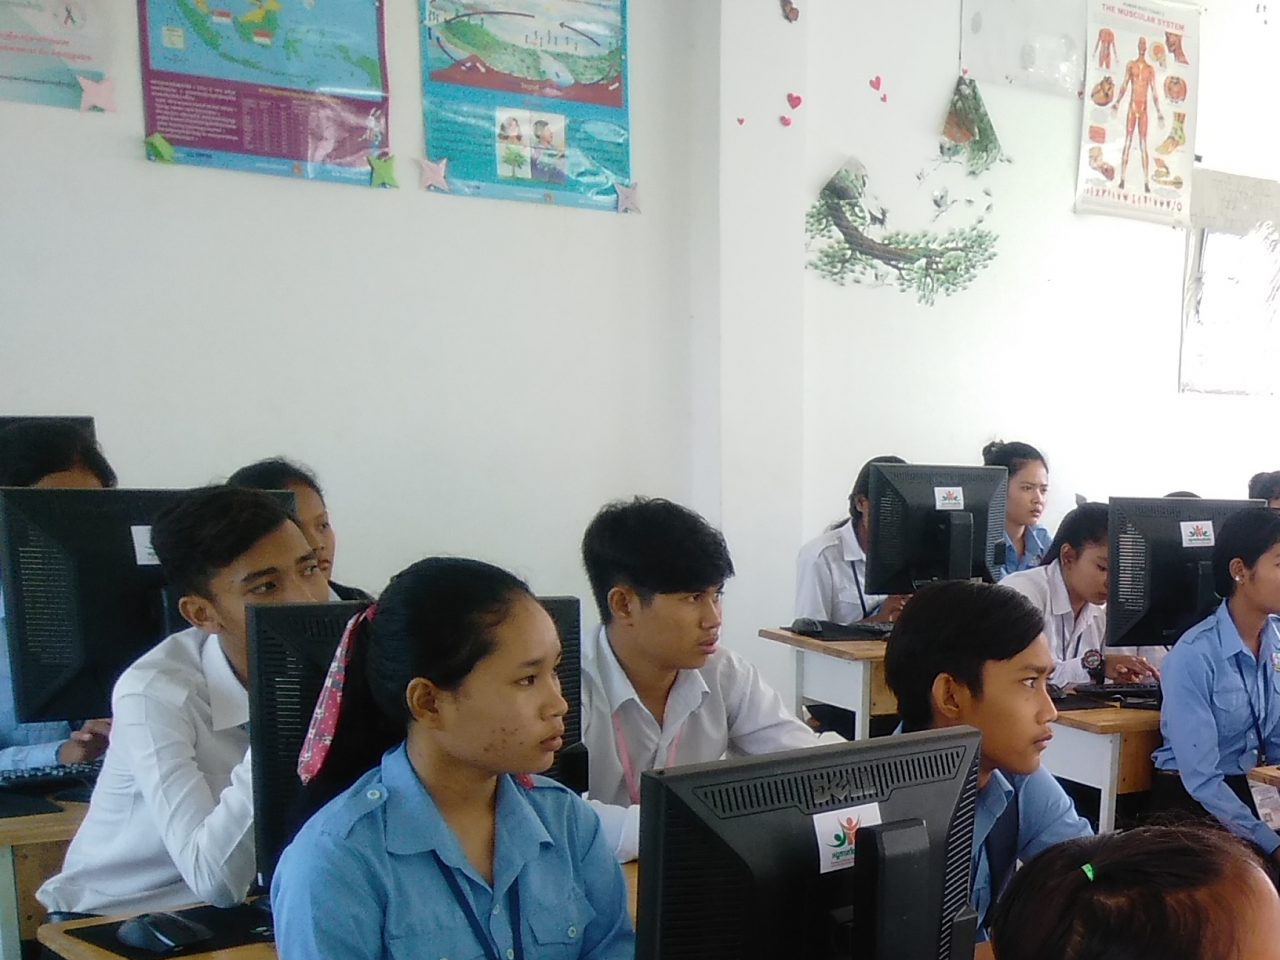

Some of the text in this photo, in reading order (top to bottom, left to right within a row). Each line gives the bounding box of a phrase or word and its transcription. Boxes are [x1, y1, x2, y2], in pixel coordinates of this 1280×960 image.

[1117, 7, 1156, 24] MUSCULAR
[1157, 18, 1185, 31] SYSTEM
[813, 769, 878, 802] DELL
